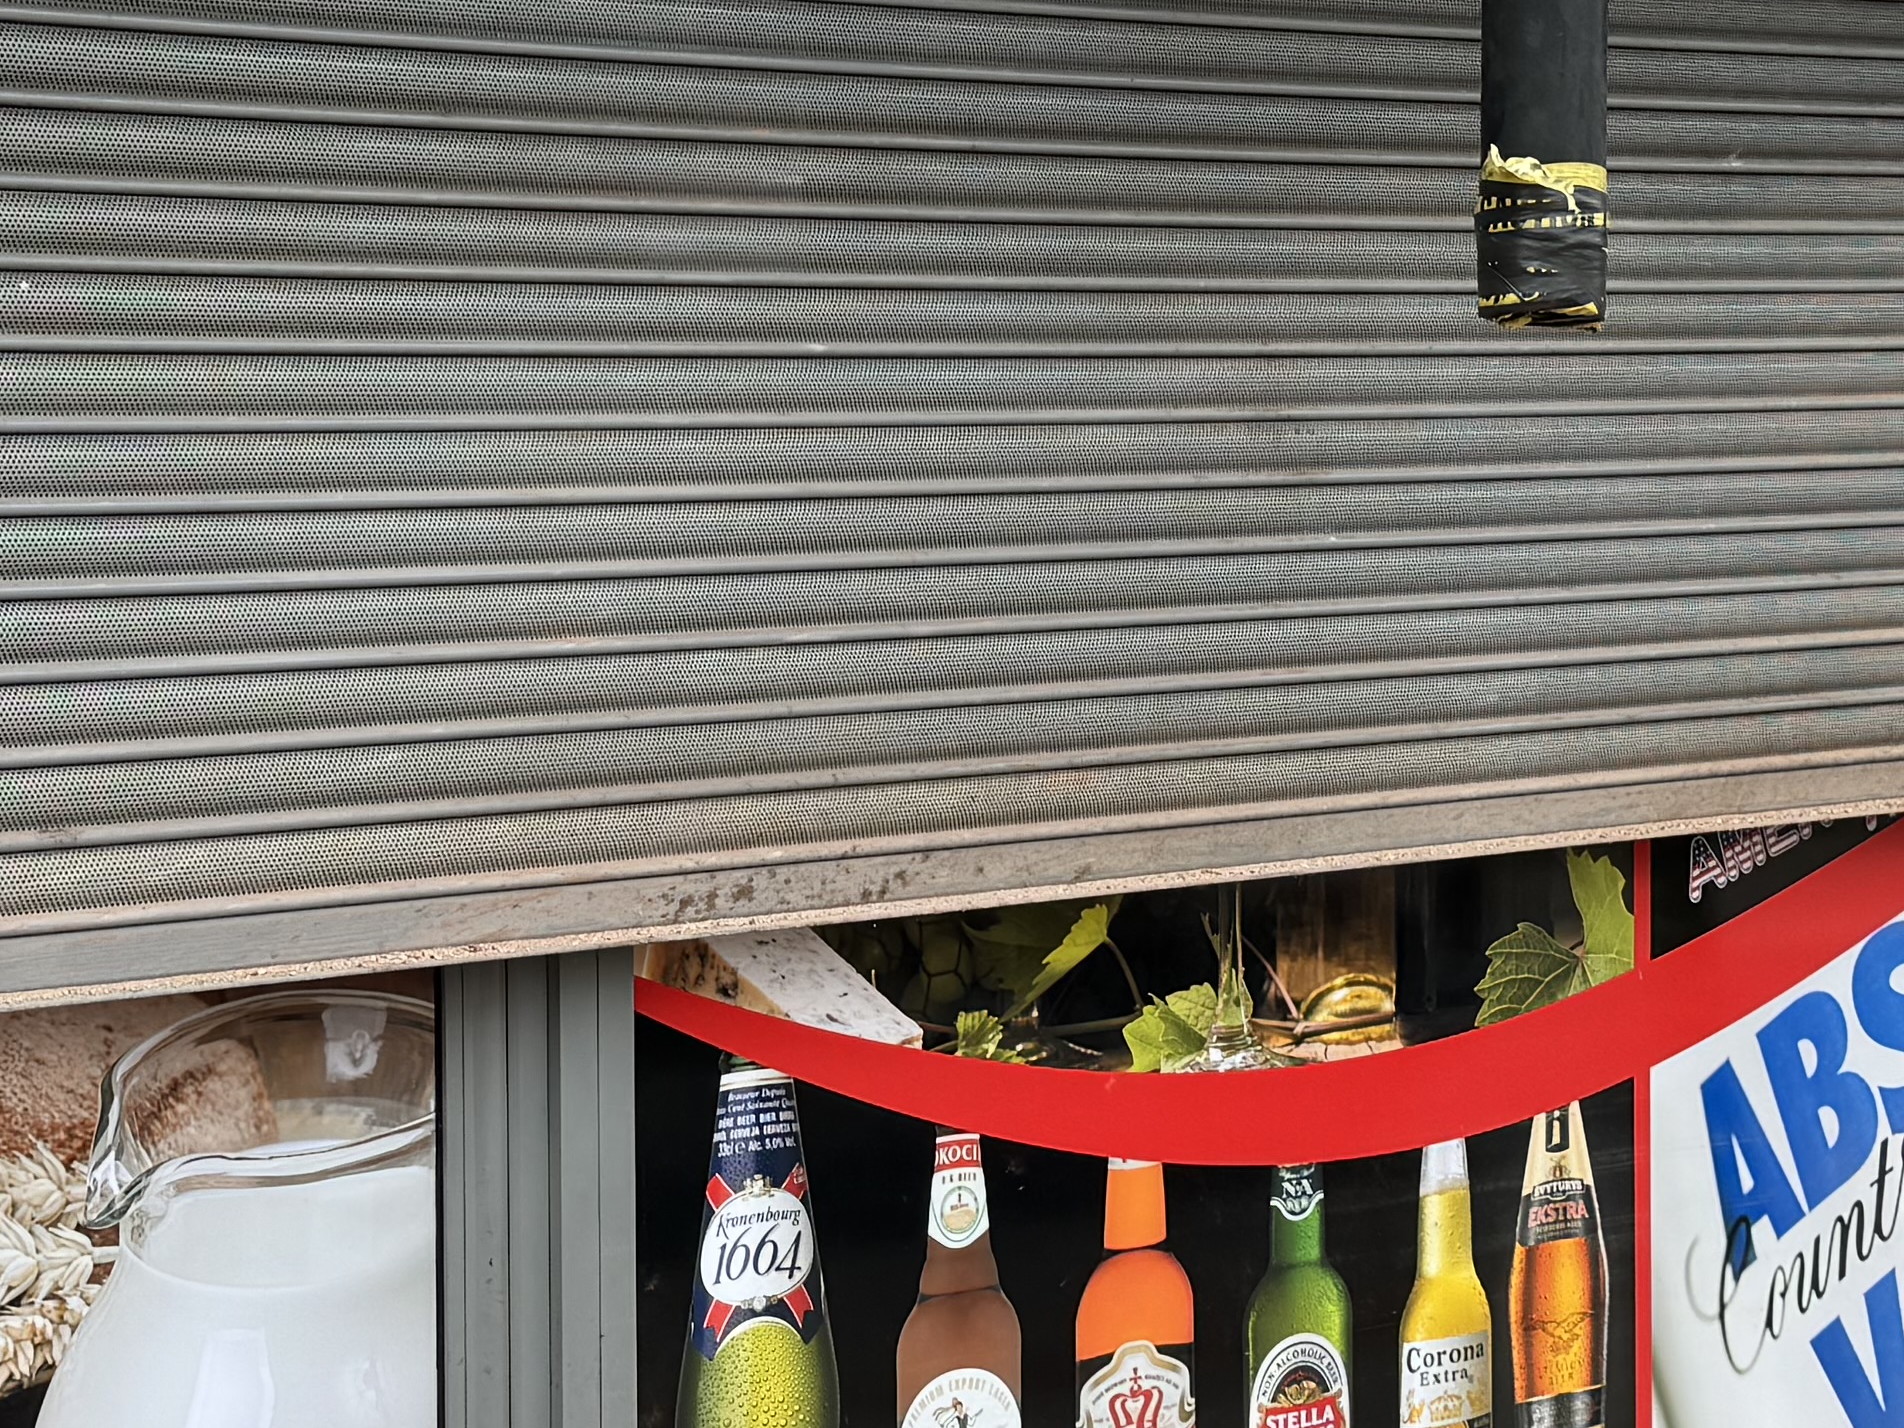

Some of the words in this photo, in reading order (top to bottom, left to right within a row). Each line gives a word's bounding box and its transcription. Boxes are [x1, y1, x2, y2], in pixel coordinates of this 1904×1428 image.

[715, 1204, 802, 1240] Kronenbourg
[1527, 1200, 1590, 1229] EKSTRA
[711, 1222, 802, 1286] 1664
[1406, 1341, 1485, 1375] Corona
[1419, 1367, 1469, 1388] Extra
[907, 1384, 946, 1428] PREMIUM
[947, 1375, 988, 1394] EXPORT
